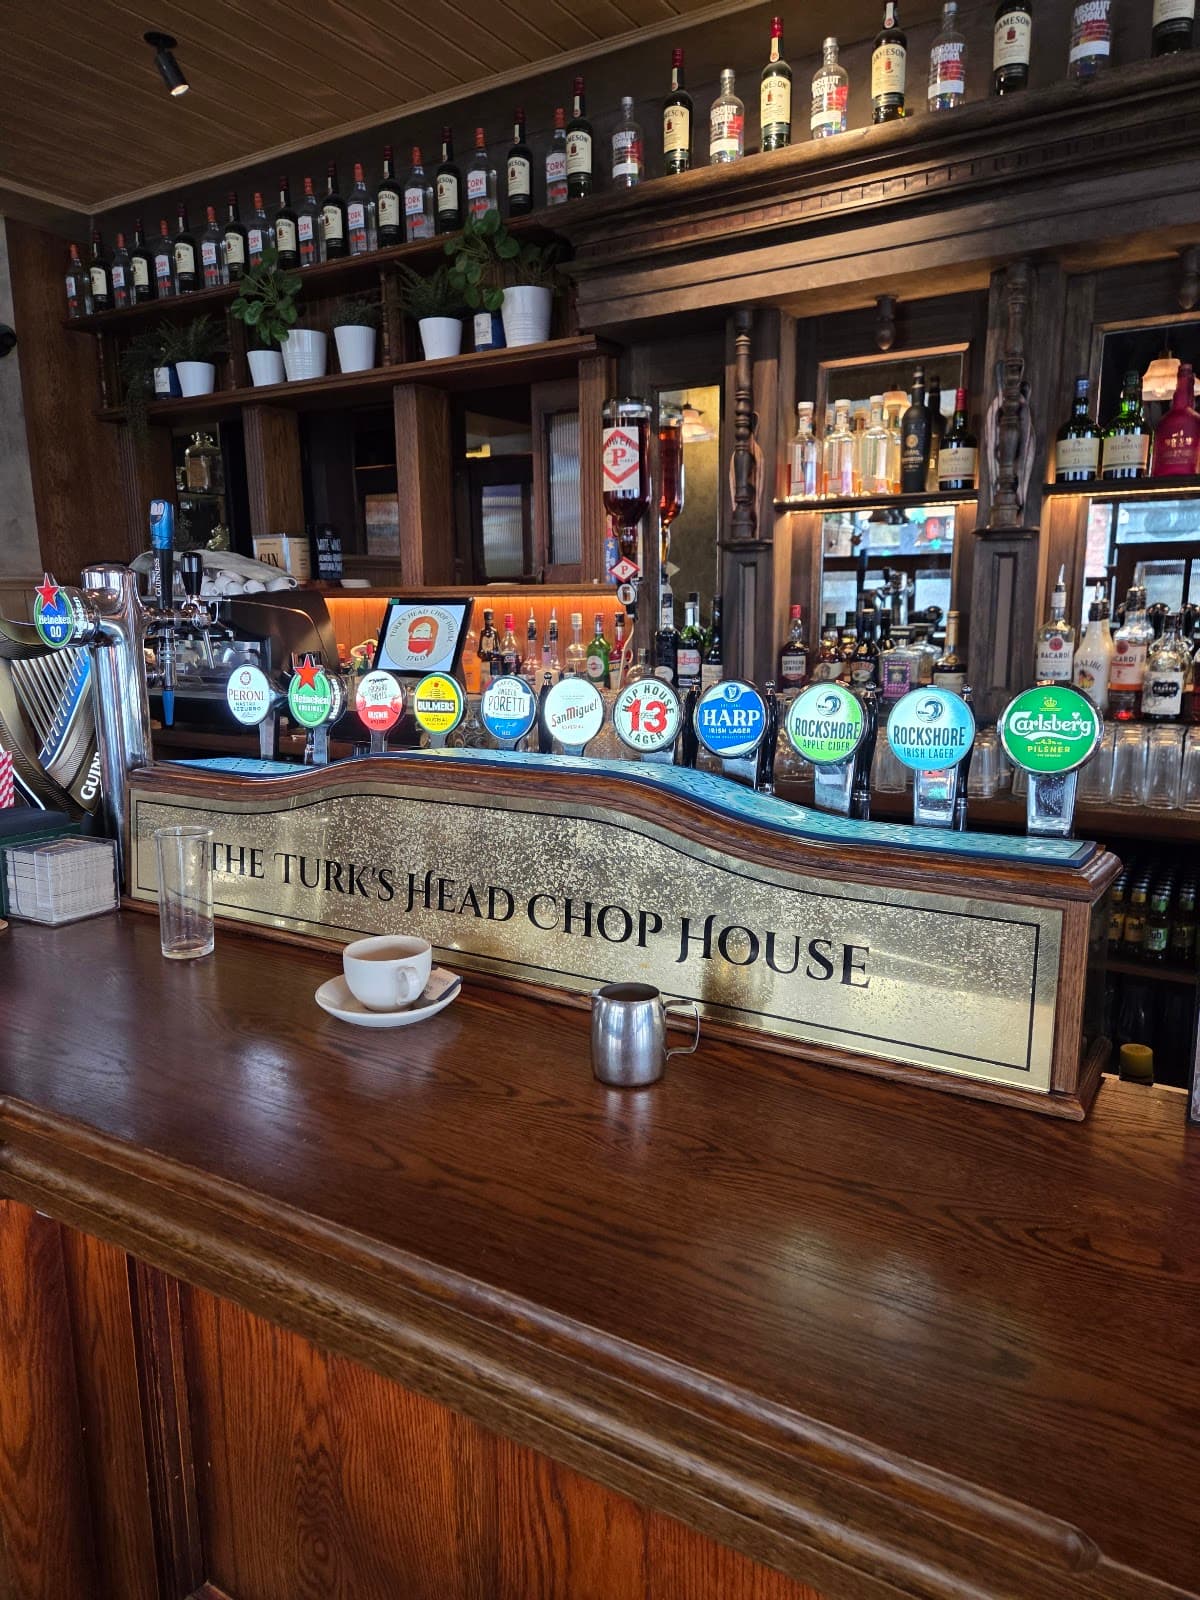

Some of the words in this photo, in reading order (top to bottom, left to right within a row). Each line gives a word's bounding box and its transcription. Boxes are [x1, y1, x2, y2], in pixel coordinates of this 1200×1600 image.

[611, 448, 627, 467] P
[229, 688, 265, 701] PERONI
[621, 688, 639, 713] HOP
[643, 684, 675, 715] HOUSE
[418, 700, 455, 711] BULMERS
[488, 695, 527, 713] PORETTI
[627, 698, 667, 733] 13
[703, 709, 761, 727] HARP
[1009, 711, 1093, 738] Carlsberg
[628, 728, 665, 745] LAGER
[794, 717, 861, 740] ROCKSHORE
[893, 725, 967, 747] ROCKSHORE
[802, 739, 825, 751] APPLE
[827, 741, 851, 752] CIDER
[903, 747, 926, 759] IRISH
[928, 747, 954, 759] LAGER
[1027, 745, 1071, 753] PILSNER
[80, 751, 101, 800] GUIN
[273, 851, 395, 902] TURK'S
[404, 869, 515, 922] HEAD
[527, 893, 663, 948] CHOP
[675, 914, 873, 989] HOUSE
